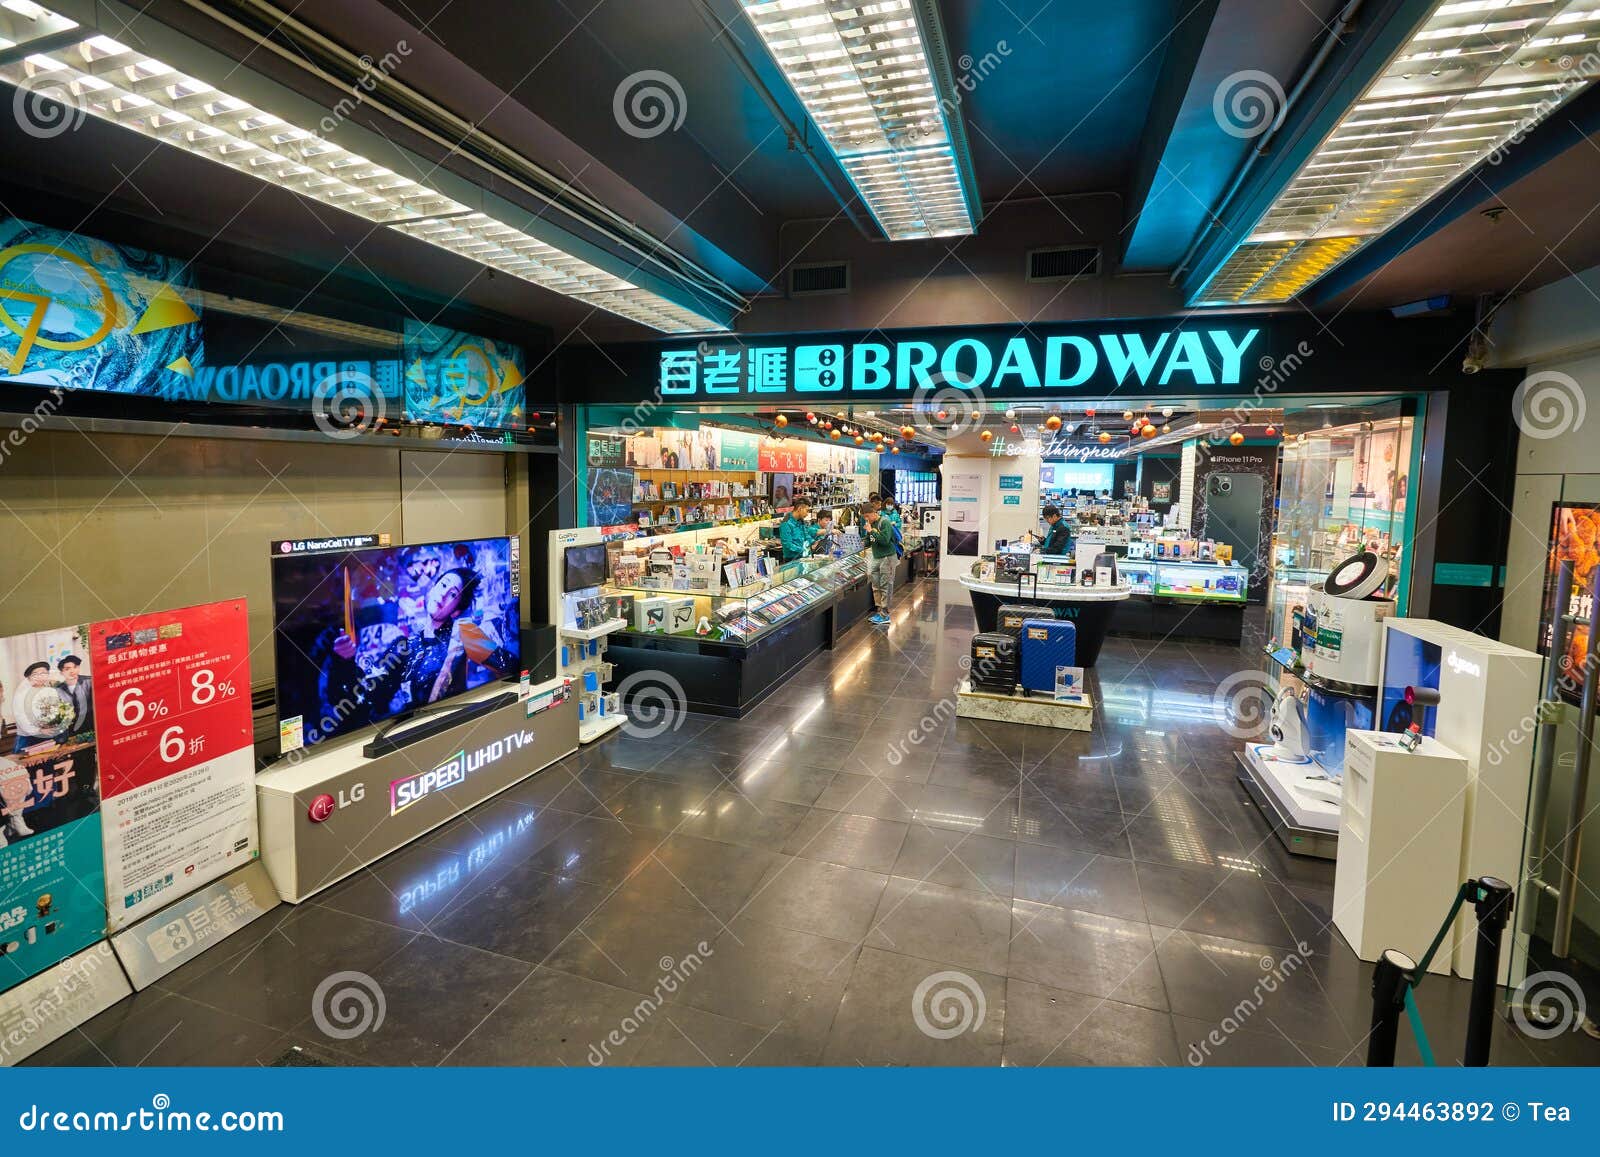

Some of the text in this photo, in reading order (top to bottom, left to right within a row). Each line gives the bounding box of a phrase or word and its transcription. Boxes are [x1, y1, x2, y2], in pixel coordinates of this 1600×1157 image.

[661, 346, 787, 396] 百老滙
[851, 329, 1259, 392] BROADWAY
[1217, 455, 1241, 463] iPhone
[292, 541, 306, 551] LG
[307, 539, 341, 550] NanoCell
[341, 538, 354, 547] TV
[1447, 651, 1481, 678] dyson
[191, 669, 236, 705] 8%
[116, 687, 169, 727] 6%
[159, 725, 206, 763] 6折
[396, 760, 461, 808] SUPER
[467, 741, 503, 772] UHD
[523, 731, 535, 745] 4K
[338, 782, 365, 809] LG
[196, 899, 257, 942] BROADWAY
